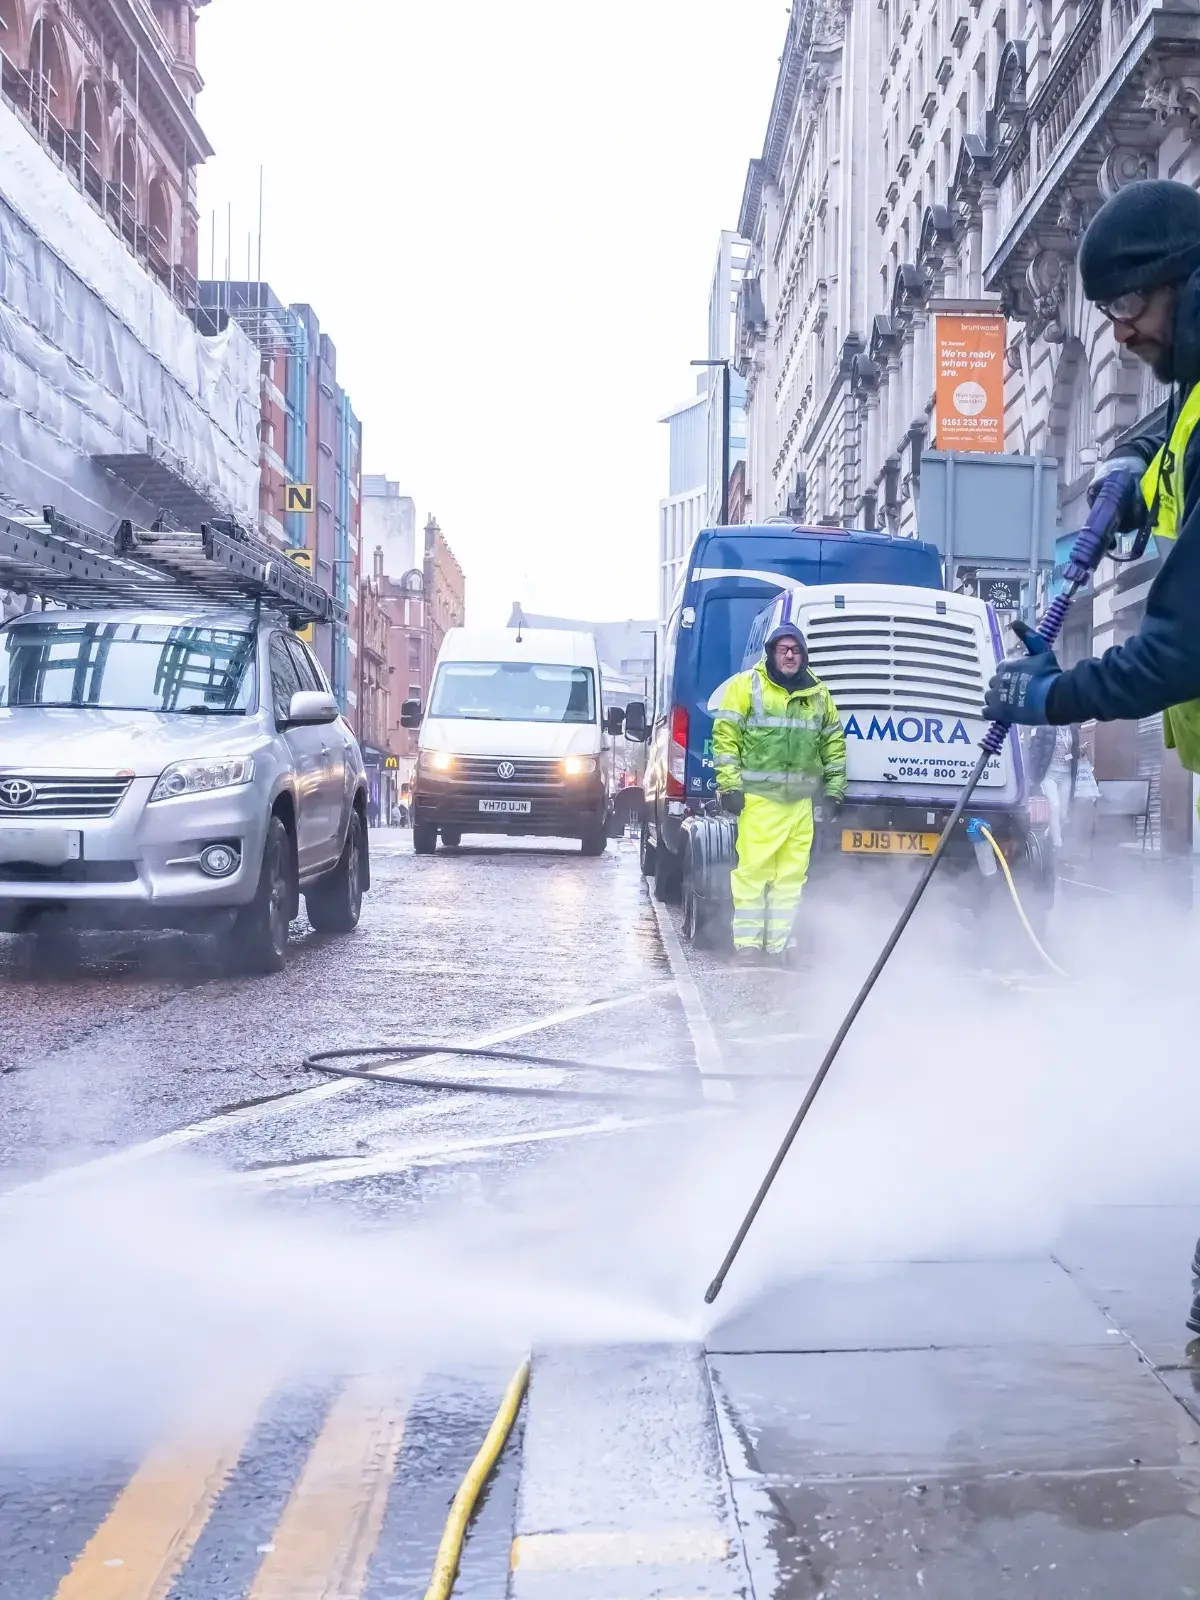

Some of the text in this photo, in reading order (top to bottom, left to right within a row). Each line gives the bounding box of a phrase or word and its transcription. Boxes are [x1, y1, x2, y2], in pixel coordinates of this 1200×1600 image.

[961, 323, 999, 331] bruntwood
[941, 349, 996, 359] We're ready
[941, 359, 987, 369] when you
[941, 369, 959, 377] are.
[942, 418, 998, 427] 0161 233 7877
[842, 714, 971, 744] AMORA
[887, 756, 1001, 769] www.ramora.cuk
[898, 766, 989, 780] 0844 800 28
[483, 801, 527, 811] YH70 UJN
[852, 831, 930, 851] BJ19 TXL
